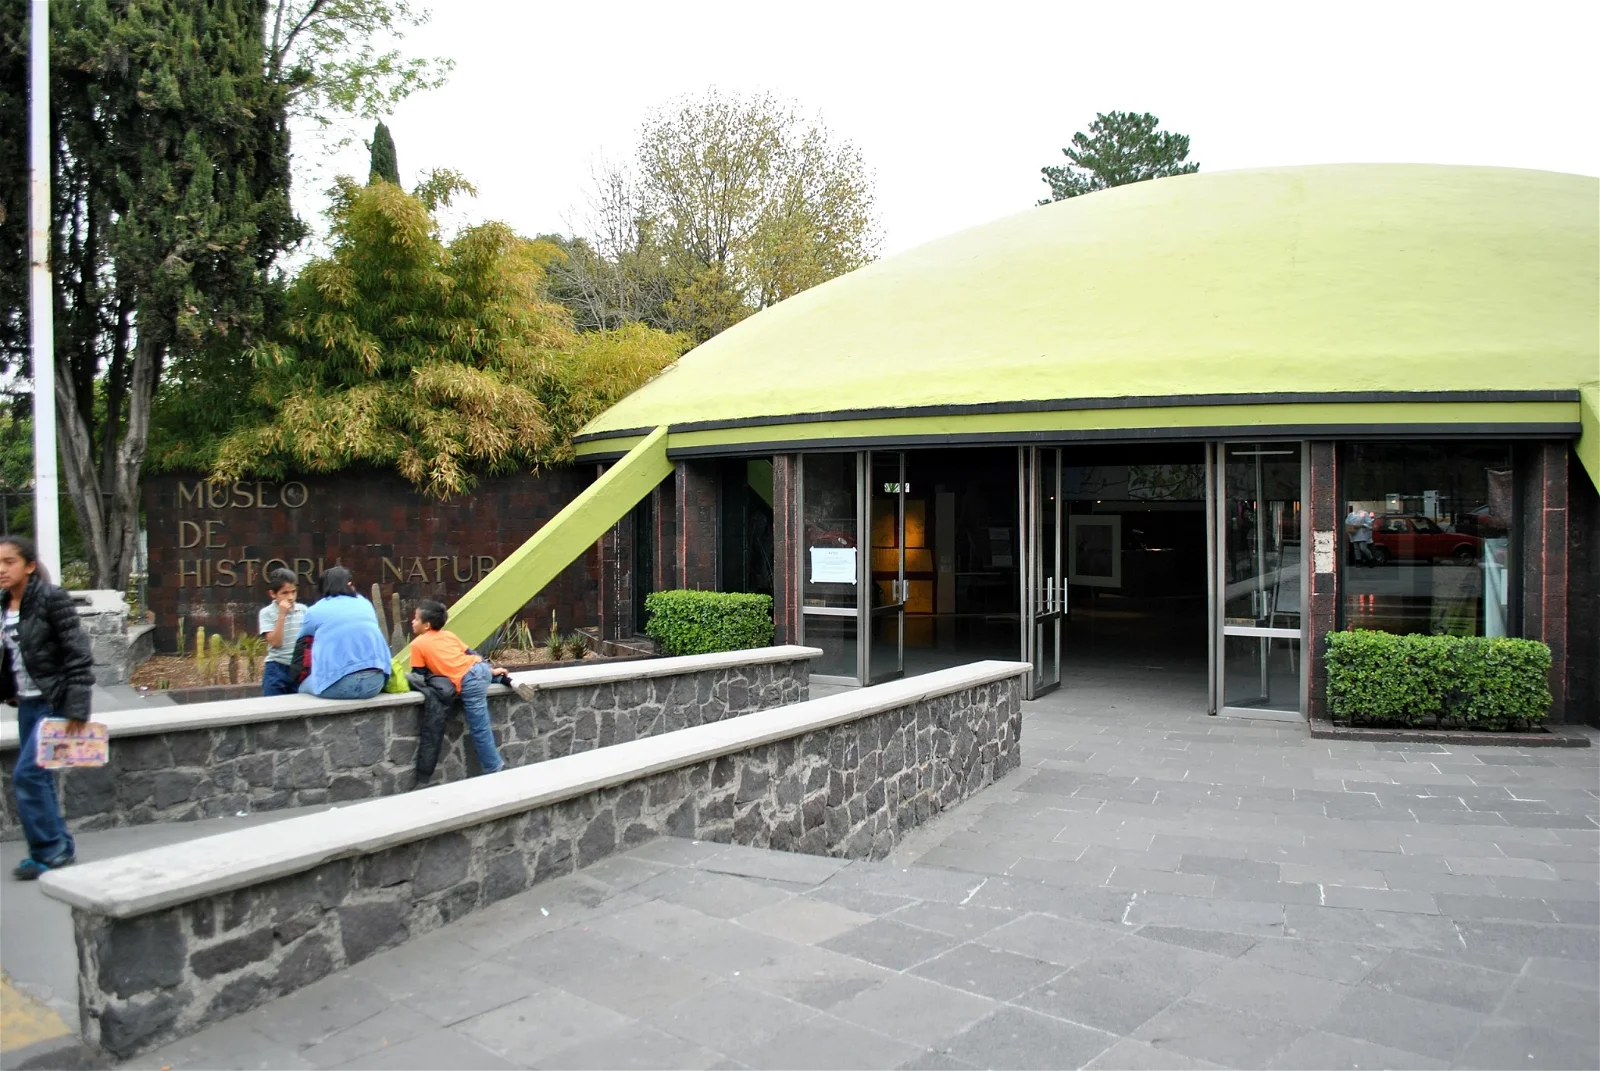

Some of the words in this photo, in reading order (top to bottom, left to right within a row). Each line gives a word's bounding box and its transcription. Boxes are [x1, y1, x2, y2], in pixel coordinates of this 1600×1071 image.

[178, 480, 309, 508] MUSEO
[178, 520, 227, 548] DE
[178, 557, 343, 587] HISTORI
[381, 555, 498, 584] NATUR
